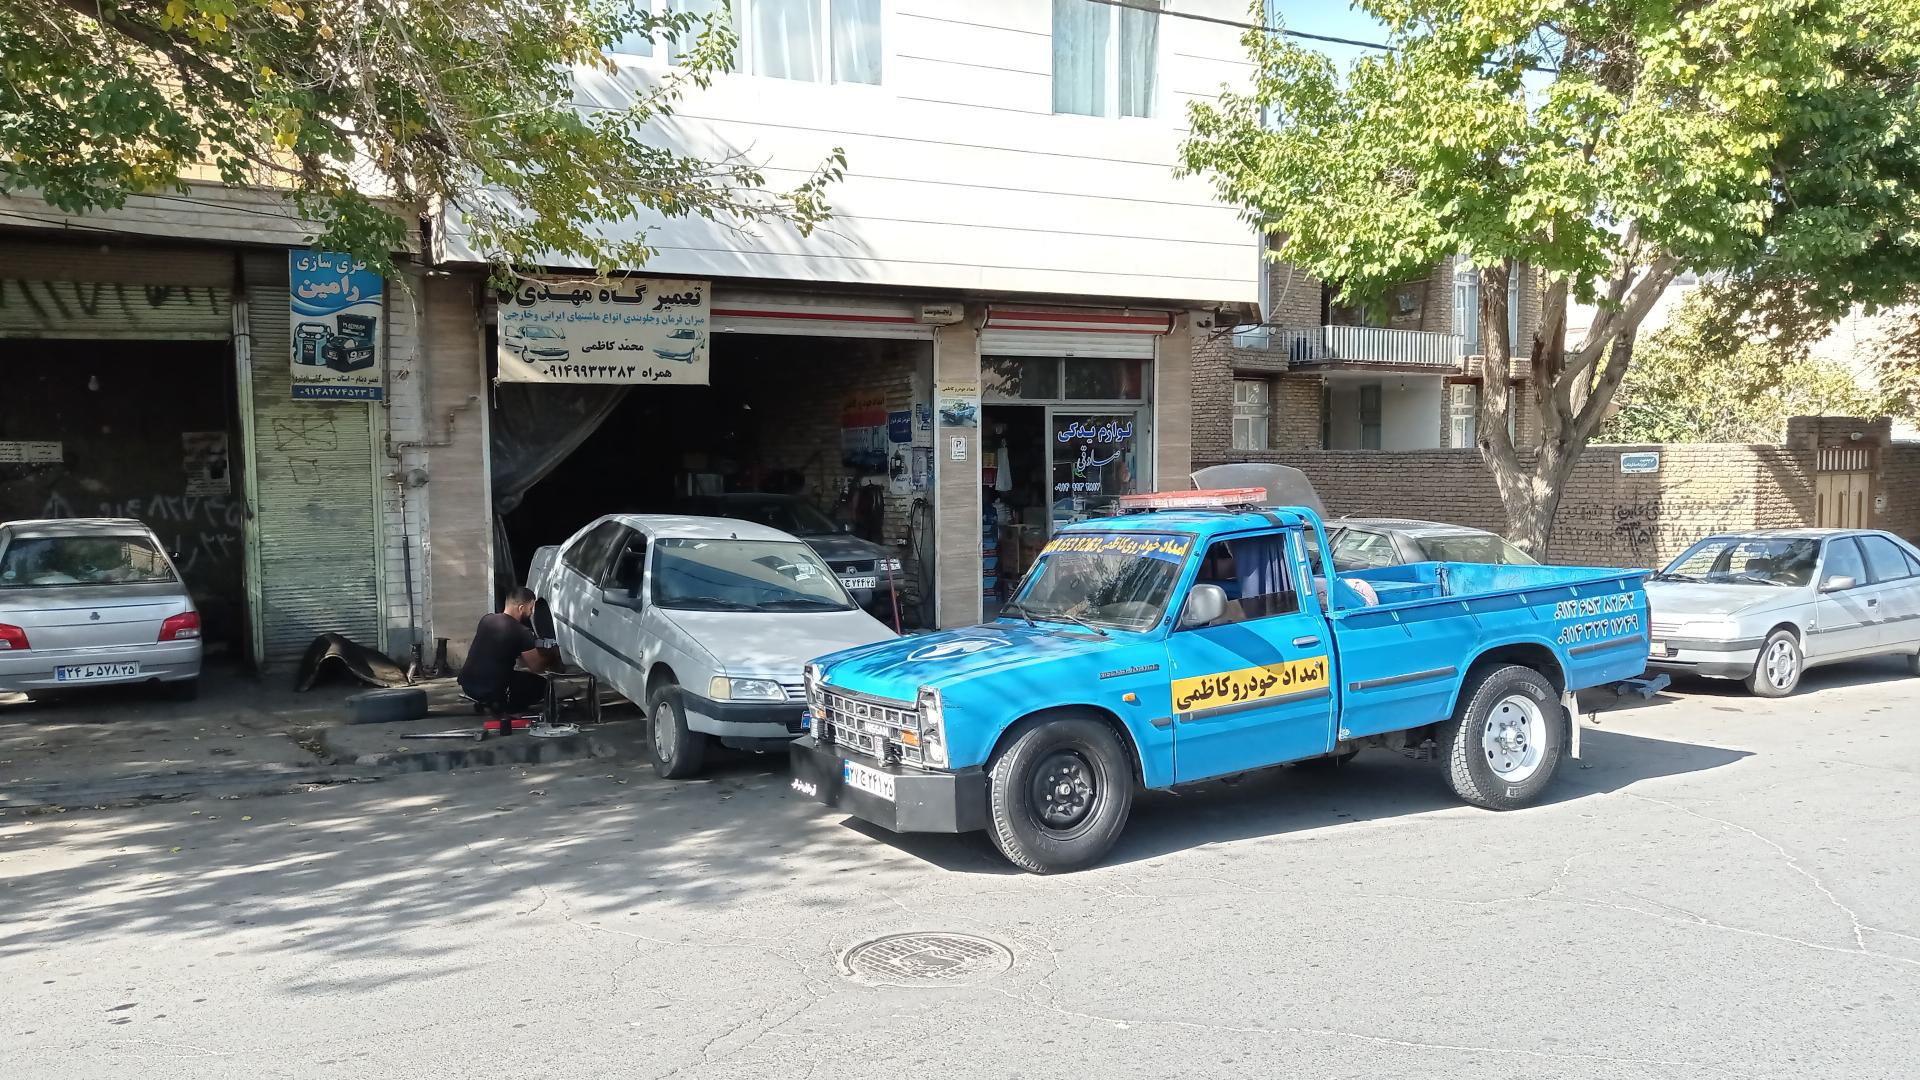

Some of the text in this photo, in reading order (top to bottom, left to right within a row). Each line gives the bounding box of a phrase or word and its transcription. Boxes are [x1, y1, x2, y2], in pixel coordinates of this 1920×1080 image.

[296, 254, 332, 272] سازی
[297, 275, 360, 302] رامین
[516, 283, 703, 311] تعمیر گاه مهدی
[542, 310, 565, 322] ایرانی
[566, 311, 600, 323] ماشینهای
[602, 312, 622, 324] انواع
[662, 314, 684, 326] فرمان
[684, 314, 705, 326] میزان
[582, 341, 616, 353] کاظمی
[642, 367, 672, 381] همراه
[1057, 421, 1133, 444] لوازم یدکی
[1076, 445, 1121, 472] صادقی
[1158, 539, 1190, 557] امداد
[1554, 591, 1635, 620] ۰۹۱۴ ۶۵۳ ۸۲۶۳
[1557, 623, 1583, 645] ۰۹۱۴
[1610, 613, 1639, 636] ۱۷۴۹
[66, 668, 82, 679] ۲۴
[96, 663, 119, 677] ۵۷۸
[1176, 660, 1324, 710] امداد خودرو کاظمی
